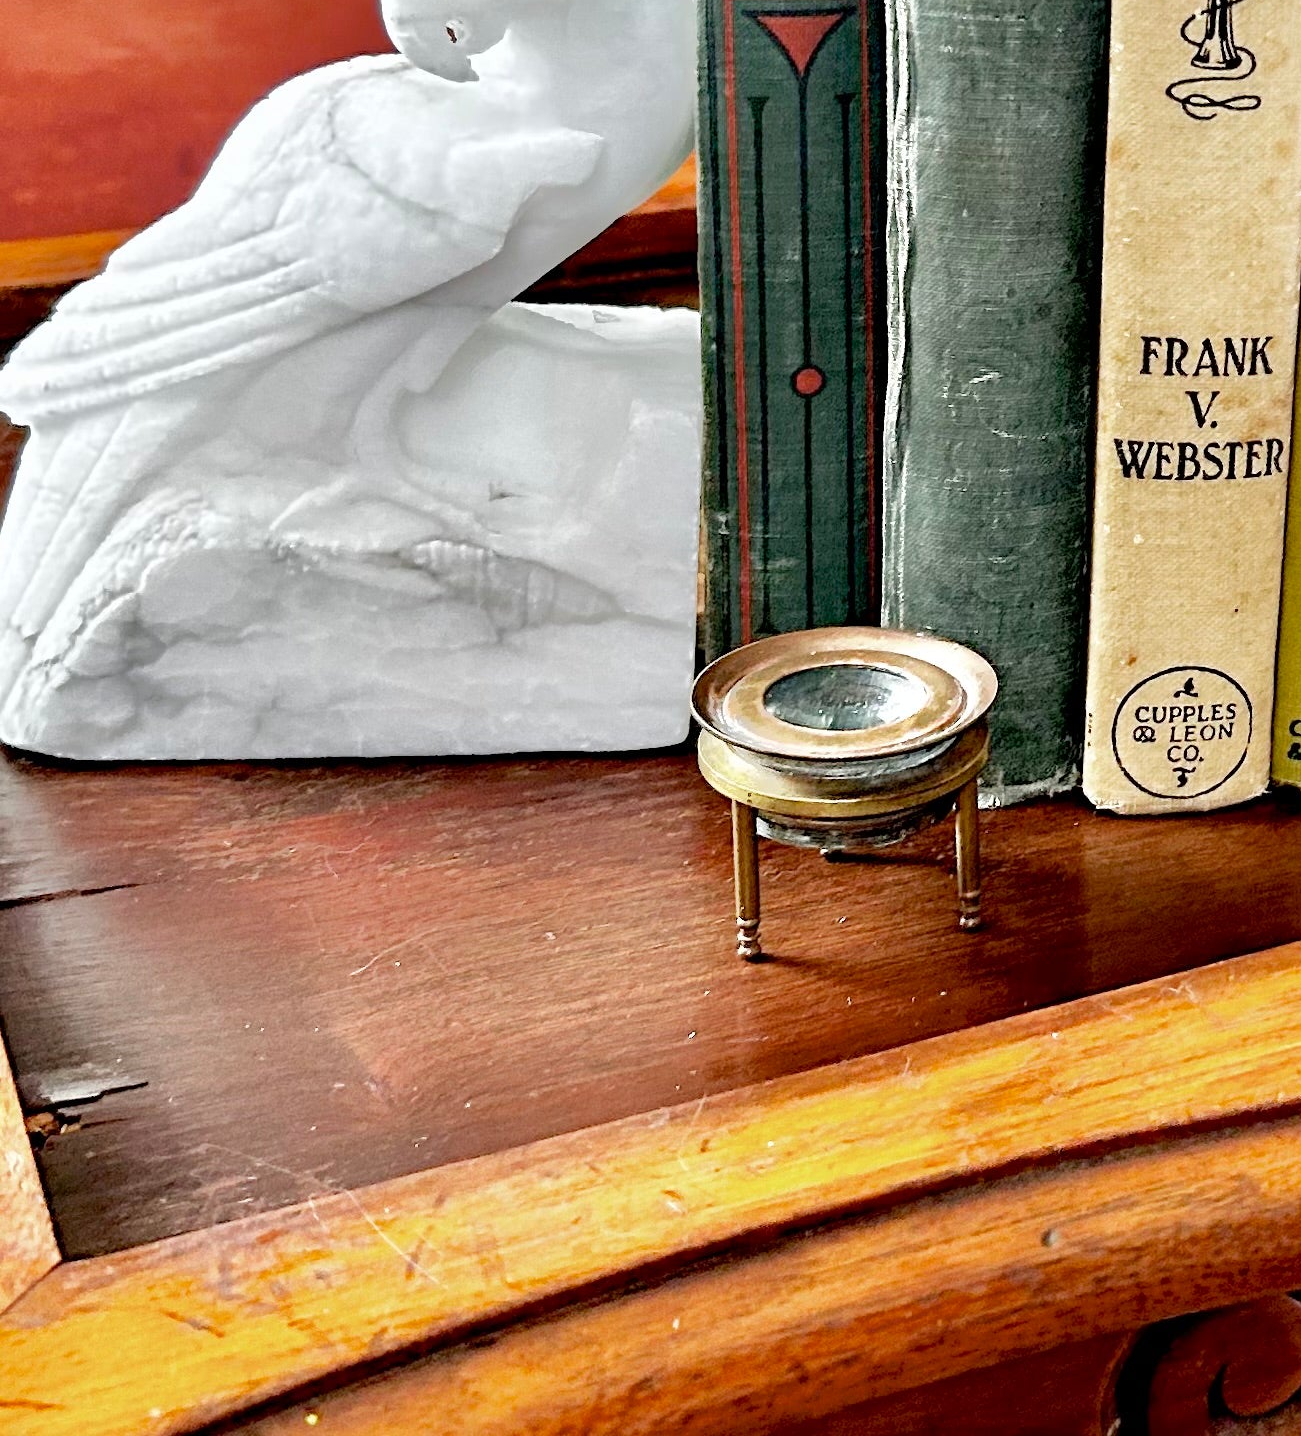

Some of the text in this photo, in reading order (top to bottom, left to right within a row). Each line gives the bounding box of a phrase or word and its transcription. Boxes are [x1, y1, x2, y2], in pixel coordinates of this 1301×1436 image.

[1139, 335, 1274, 377] FRANK
[1185, 390, 1221, 428] V.
[1113, 438, 1285, 481] WEBSTER
[1134, 703, 1238, 723] CUPPLES
[1169, 722, 1235, 743] LEON
[1166, 744, 1205, 763] CO.
